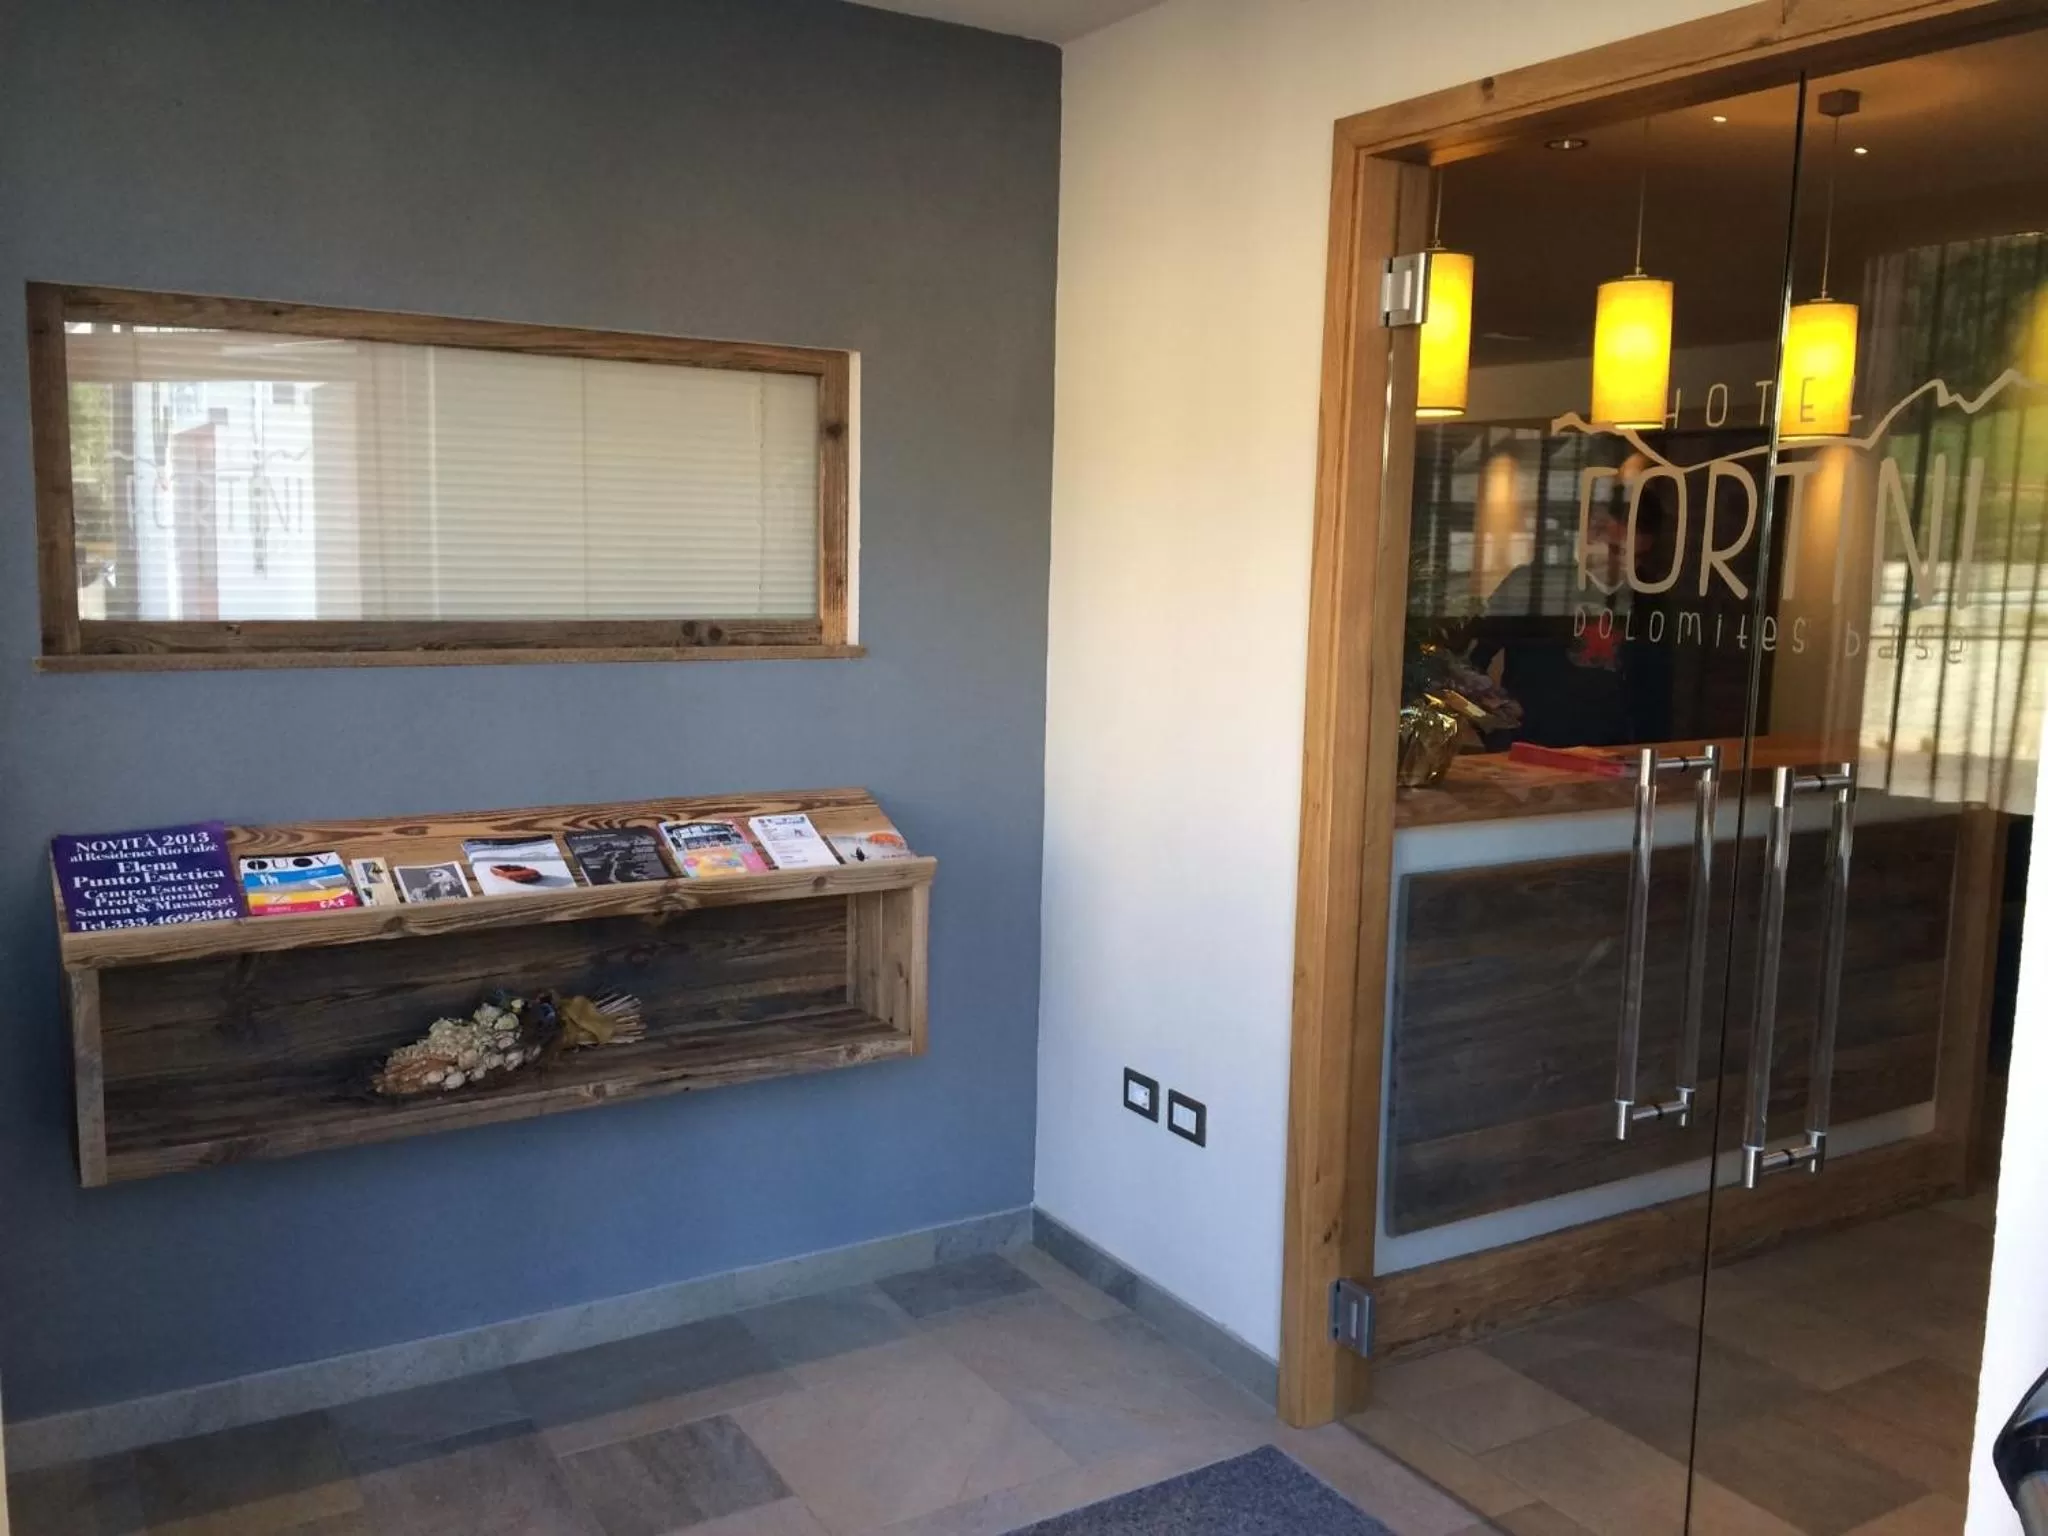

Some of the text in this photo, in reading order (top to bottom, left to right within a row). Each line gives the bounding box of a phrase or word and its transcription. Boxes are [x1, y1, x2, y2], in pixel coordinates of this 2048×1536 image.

[1660, 375, 1864, 431] HOTEL
[1577, 453, 1986, 611] FORTINI
[75, 831, 210, 853] NOVITÀ 2013
[69, 852, 83, 864] al
[84, 848, 156, 863] Residence
[157, 846, 182, 857] Rio
[117, 861, 178, 874] Elena
[72, 868, 225, 889] Punto Estetica
[84, 881, 219, 900] Centro Estetico
[94, 890, 213, 908] Professionale
[75, 895, 234, 918] Sauna & Massaggi
